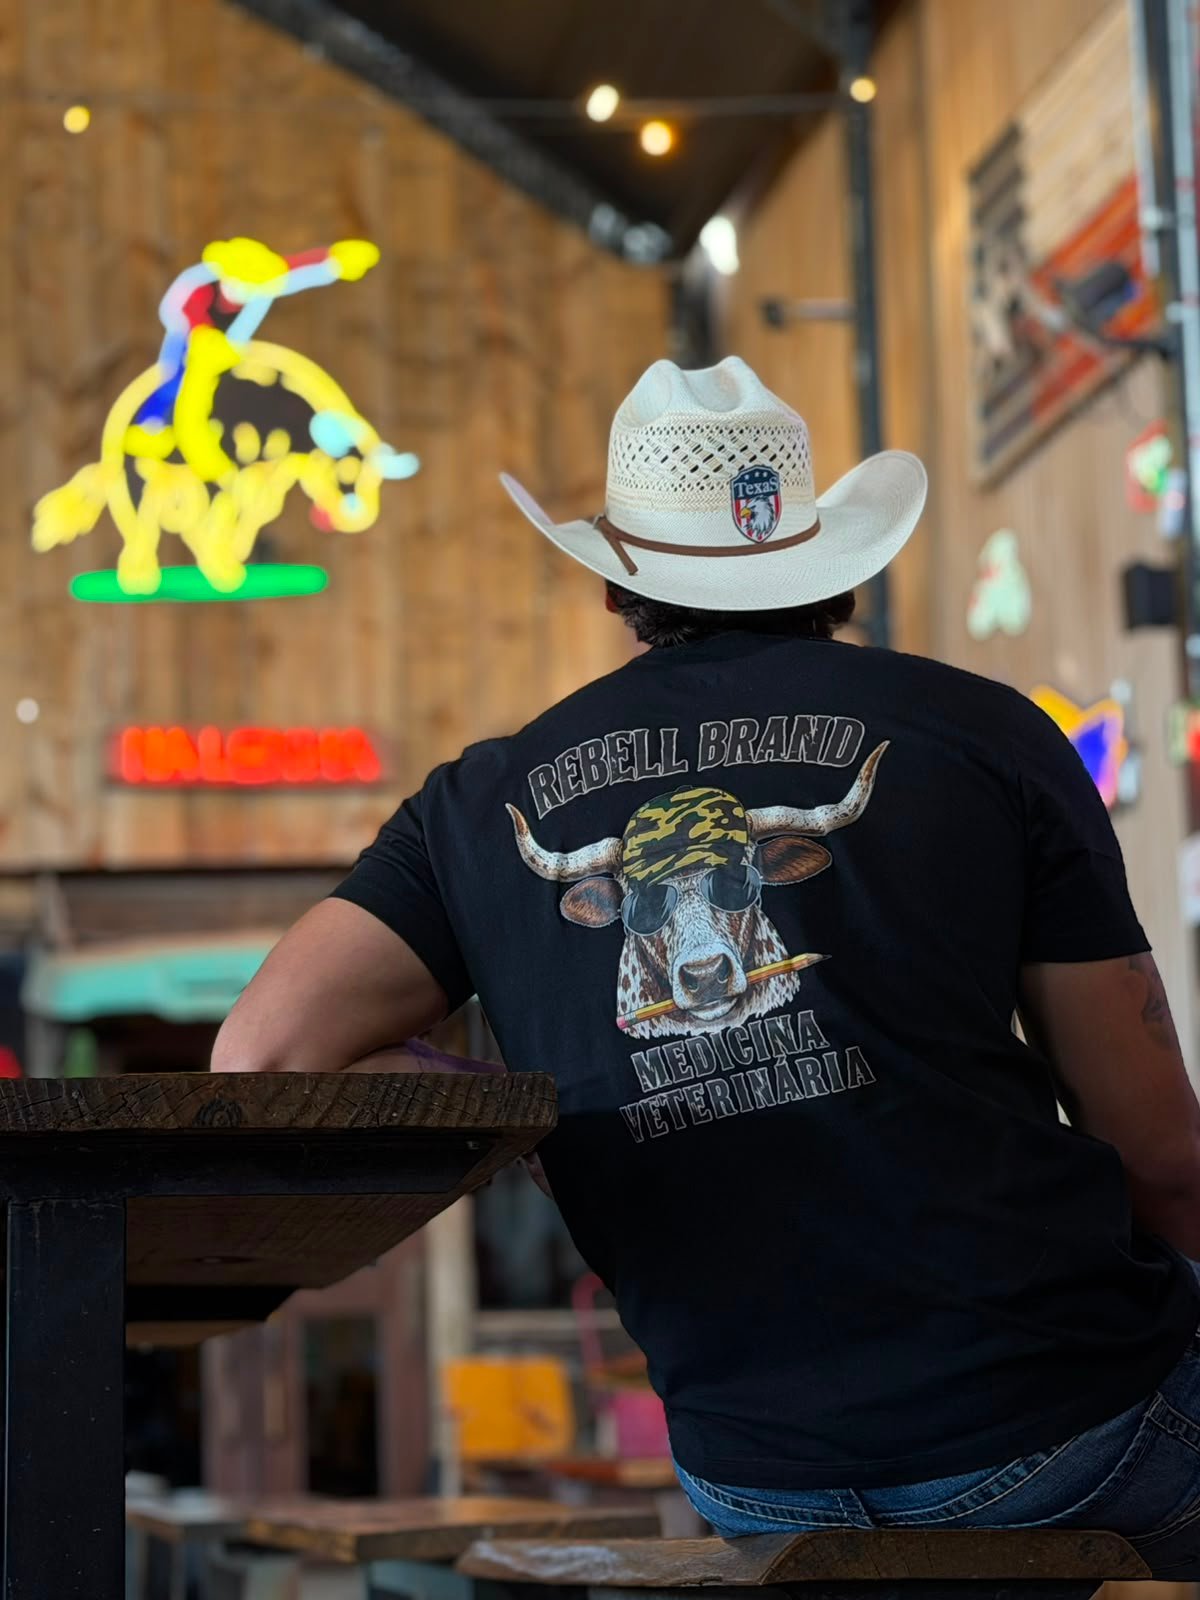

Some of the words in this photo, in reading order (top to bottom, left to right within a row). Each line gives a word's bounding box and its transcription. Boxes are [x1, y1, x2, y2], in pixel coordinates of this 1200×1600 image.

[528, 728, 688, 819] REBELL
[697, 715, 865, 772] BRAND
[619, 1046, 877, 1143] VETERINÁRIA
[631, 1010, 830, 1093] MEDICINA
